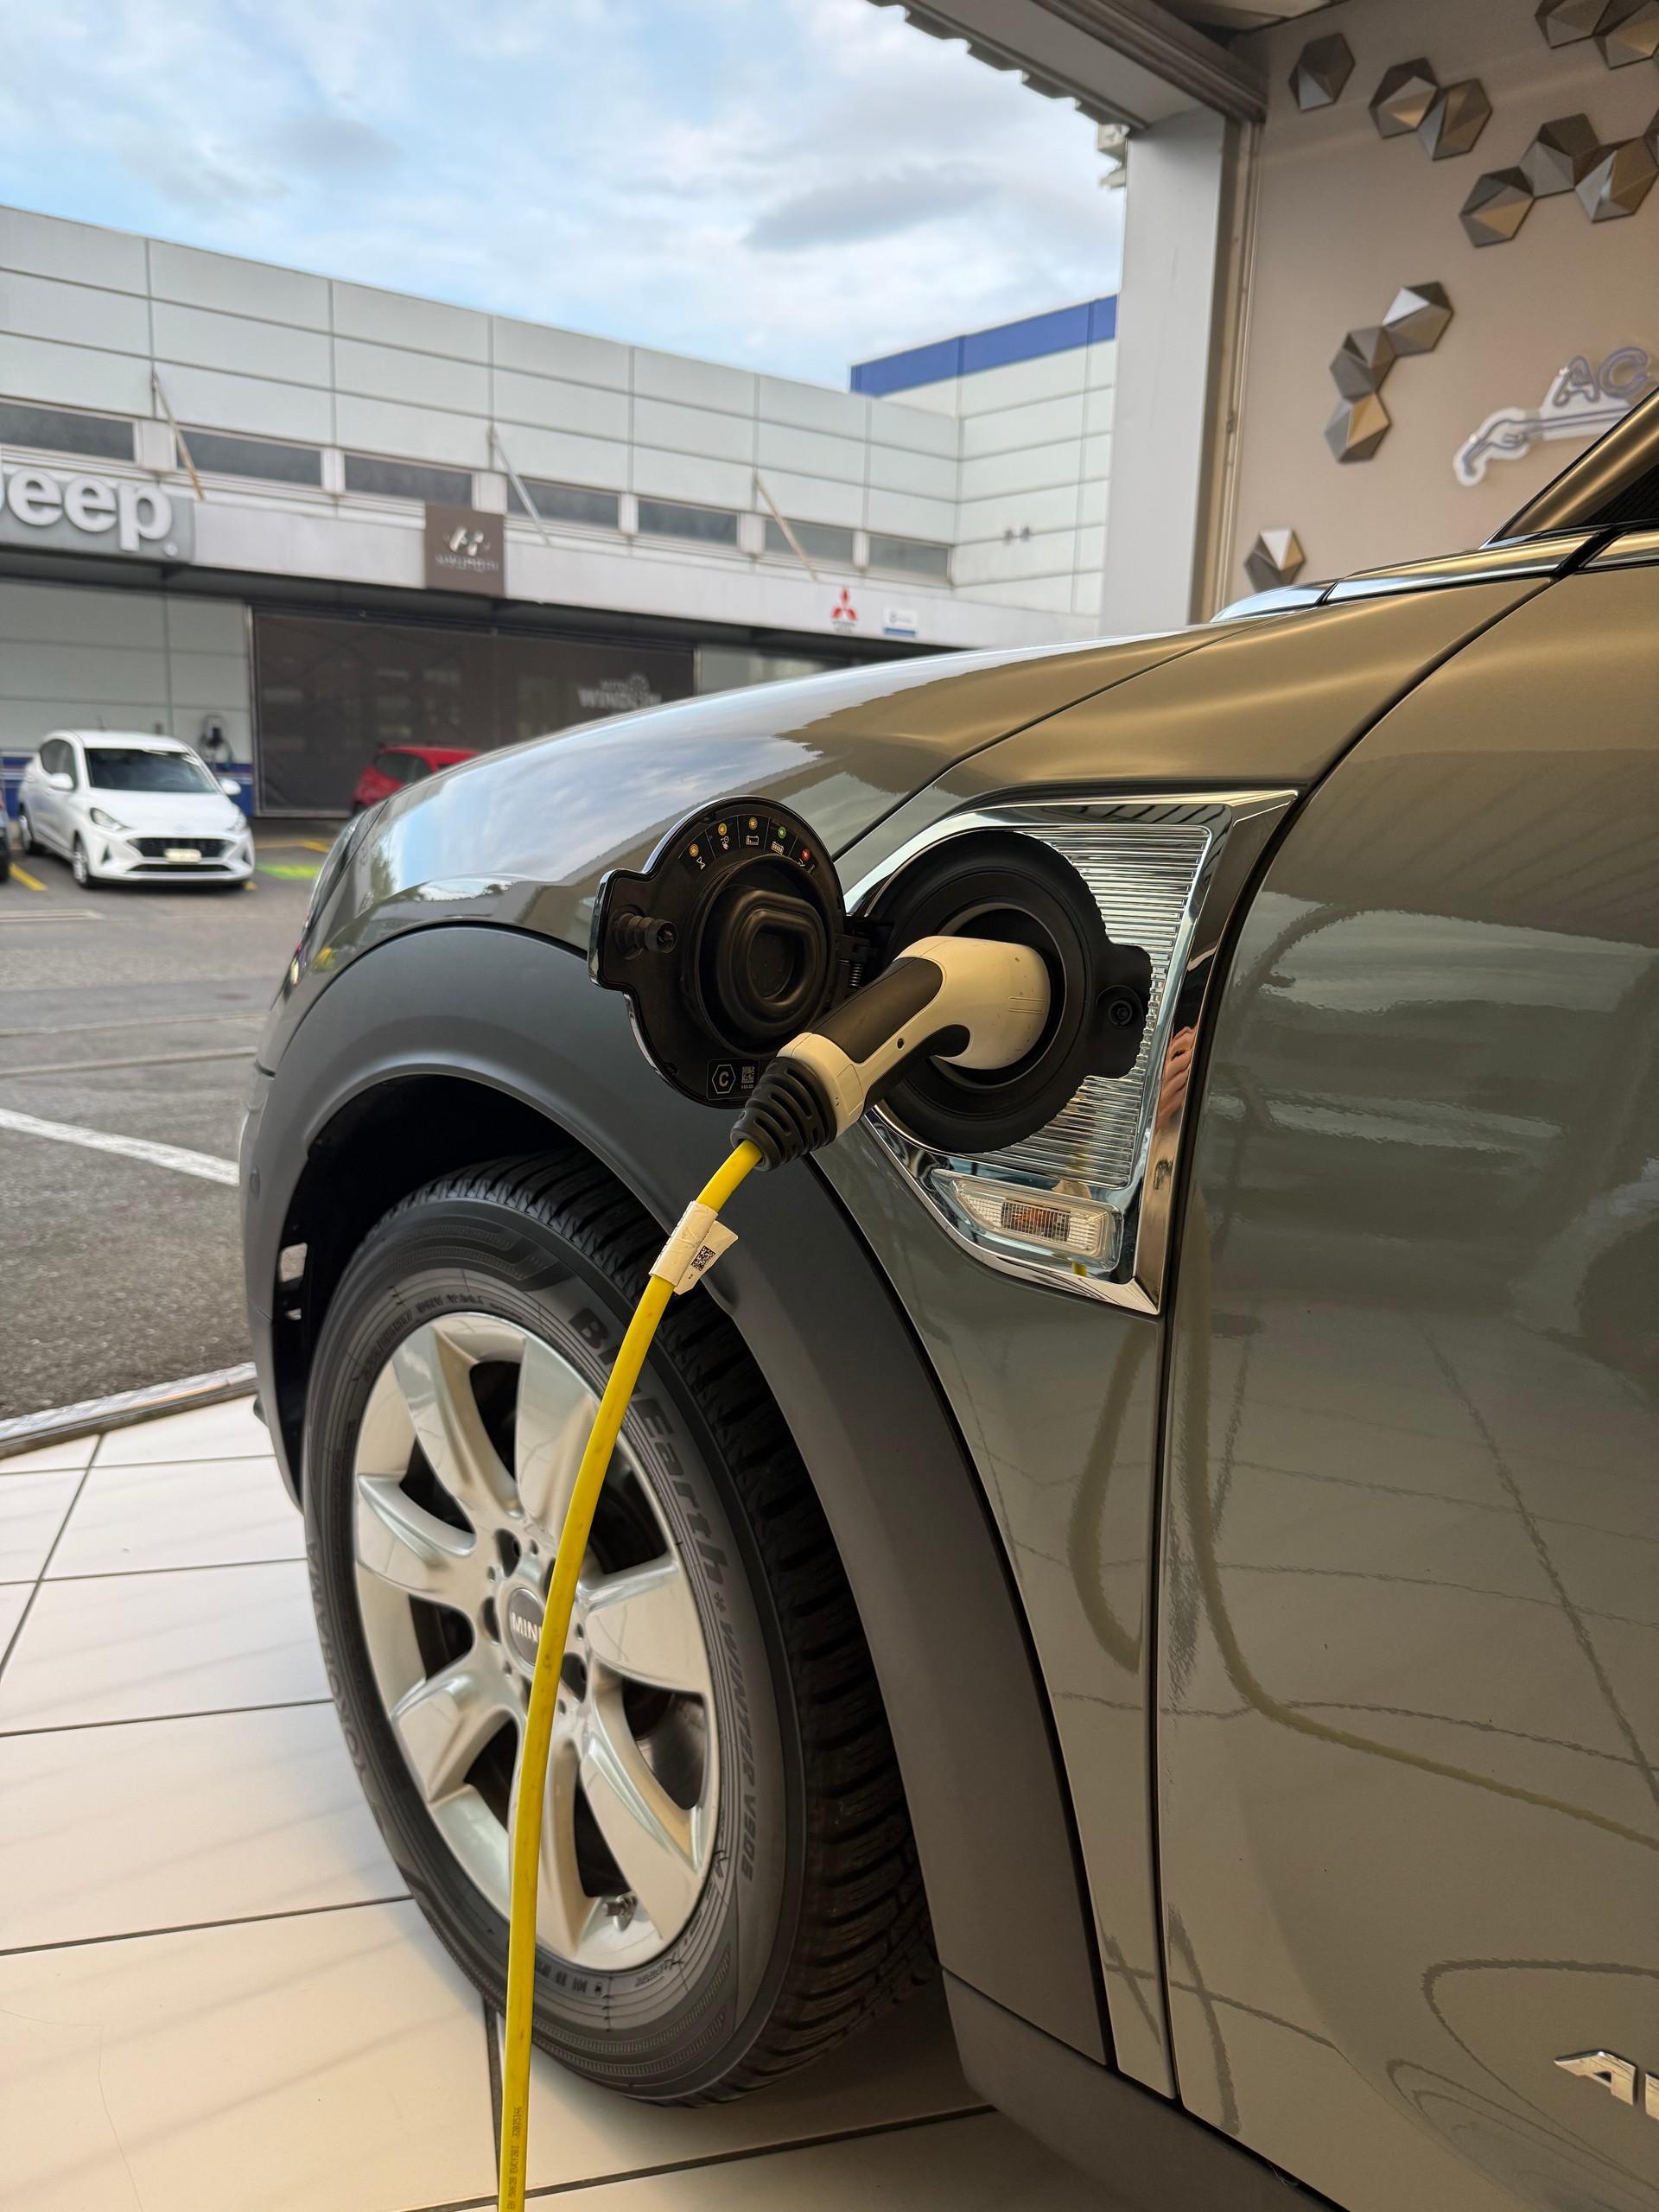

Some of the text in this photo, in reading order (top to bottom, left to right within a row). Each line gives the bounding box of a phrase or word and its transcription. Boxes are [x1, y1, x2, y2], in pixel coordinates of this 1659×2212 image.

[0, 467, 173, 552] eep
[718, 1071, 729, 1087] C
[569, 1307, 728, 1585] BlEarth
[720, 1621, 754, 1787] WINTER
